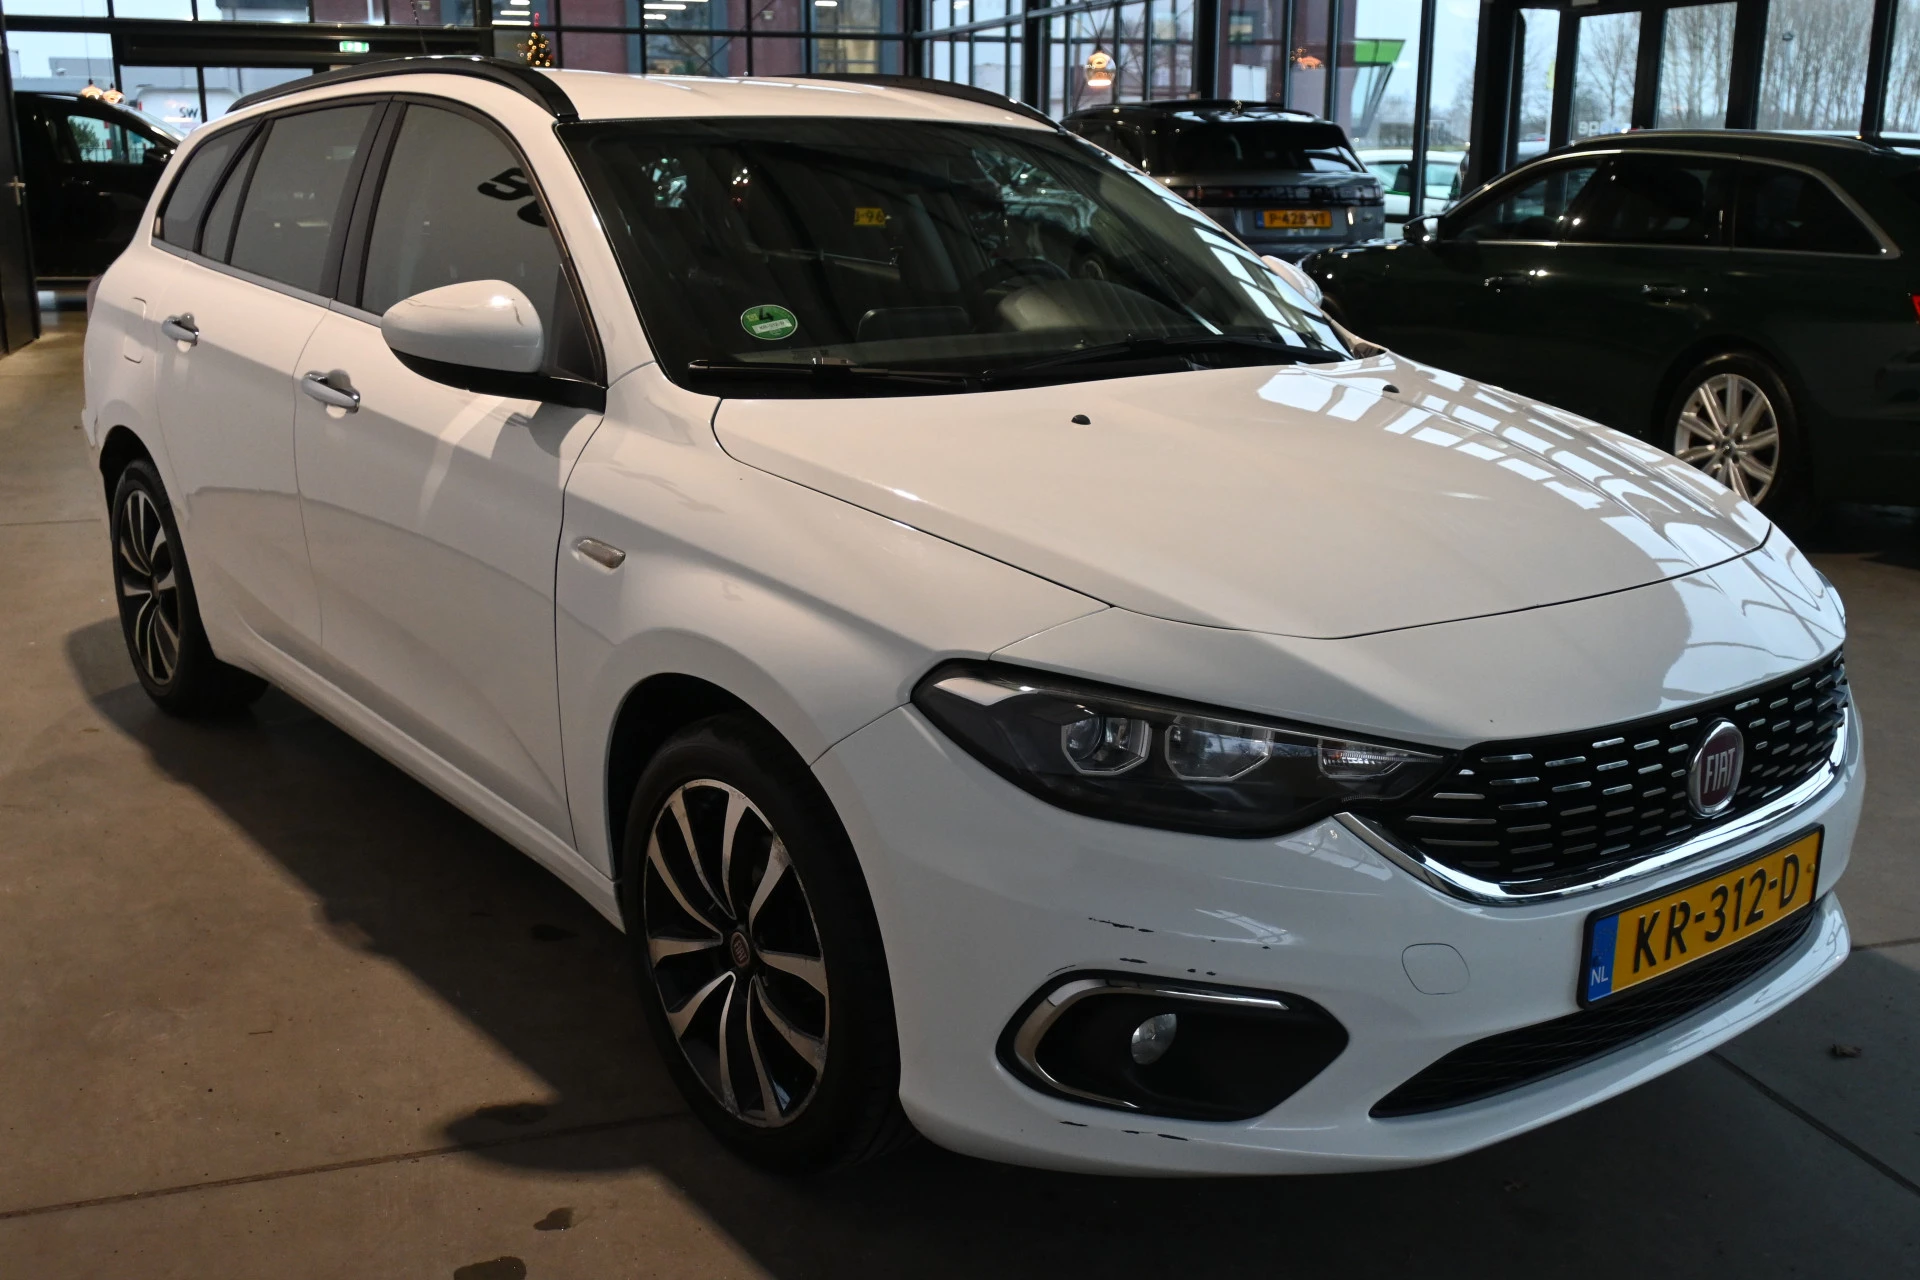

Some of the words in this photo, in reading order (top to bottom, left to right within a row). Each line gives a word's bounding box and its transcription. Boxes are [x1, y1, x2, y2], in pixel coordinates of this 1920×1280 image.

[1703, 747, 1736, 794] FIAT
[1633, 853, 1801, 974] KR-312-D
[1590, 965, 1609, 987] NL
